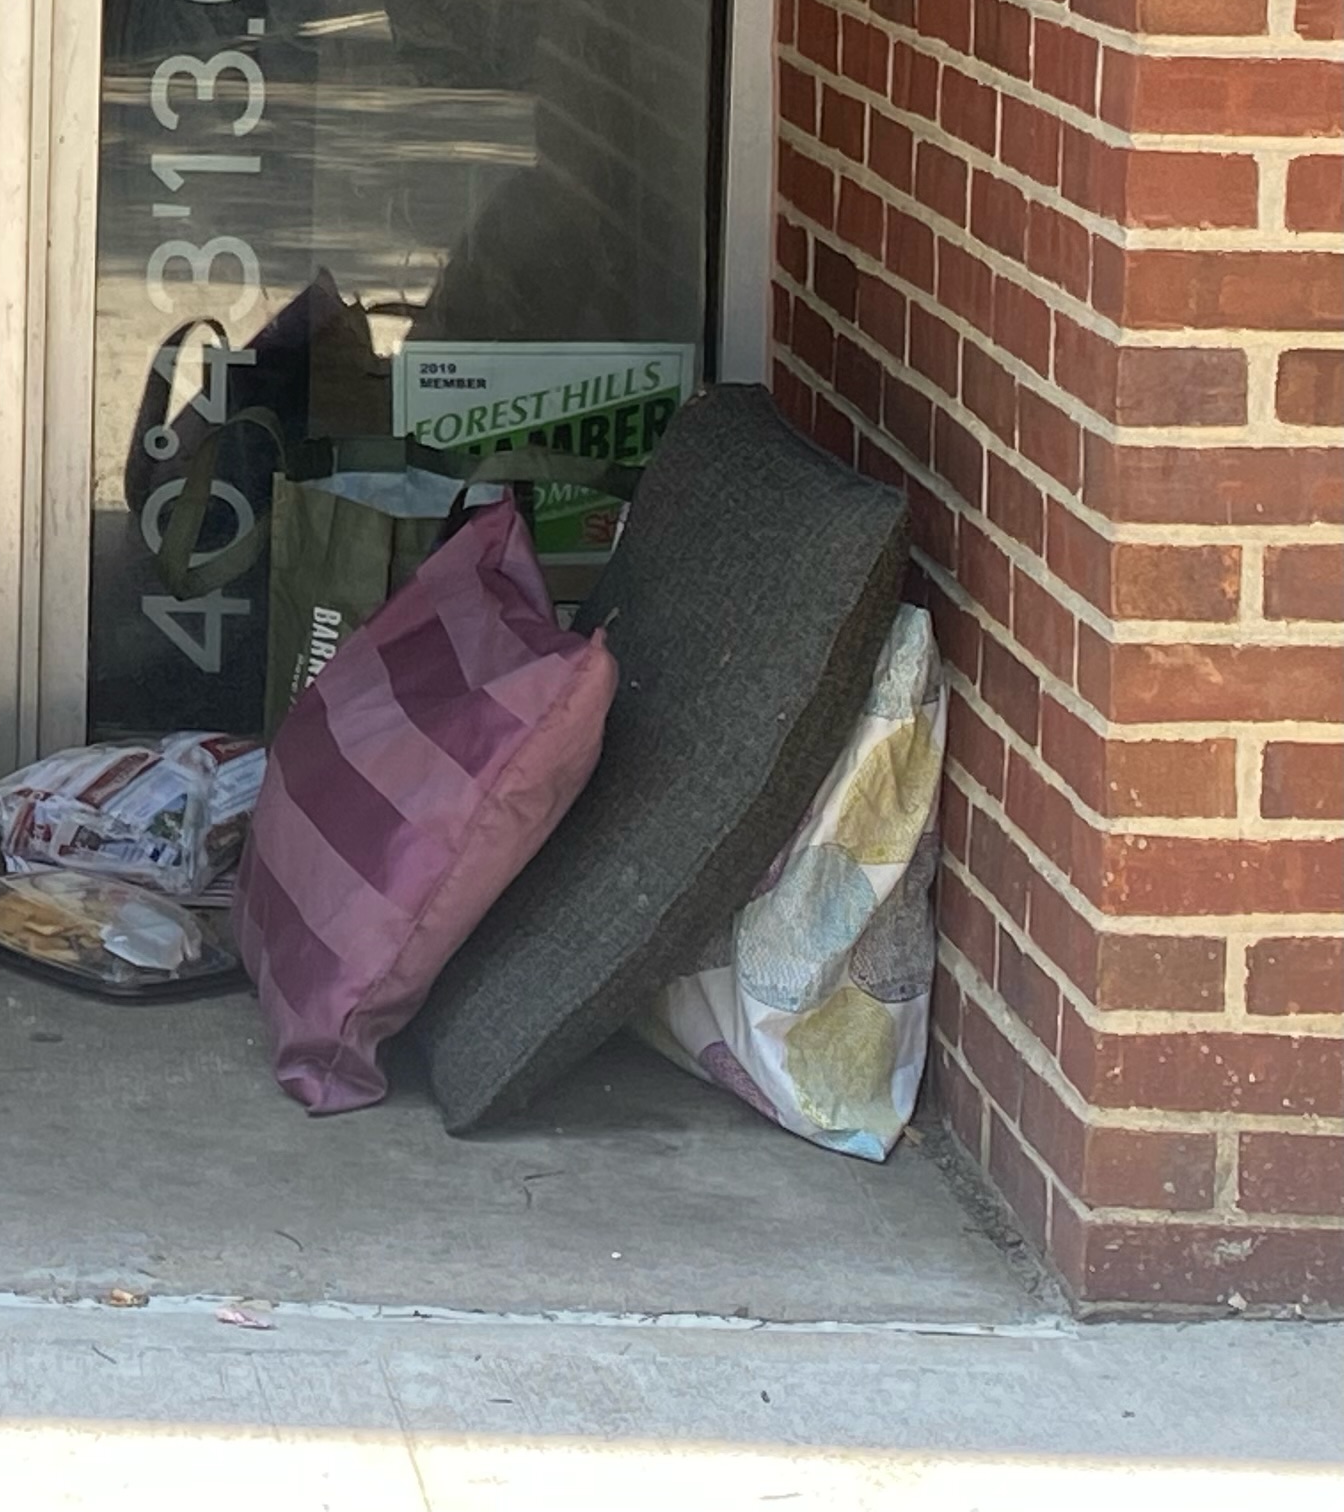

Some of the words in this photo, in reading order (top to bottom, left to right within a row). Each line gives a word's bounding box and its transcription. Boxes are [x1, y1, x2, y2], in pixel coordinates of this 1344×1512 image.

[419, 363, 457, 375] 2019
[419, 378, 487, 389] MEMBER
[415, 390, 551, 444] FOREST
[562, 360, 662, 414] HILLS
